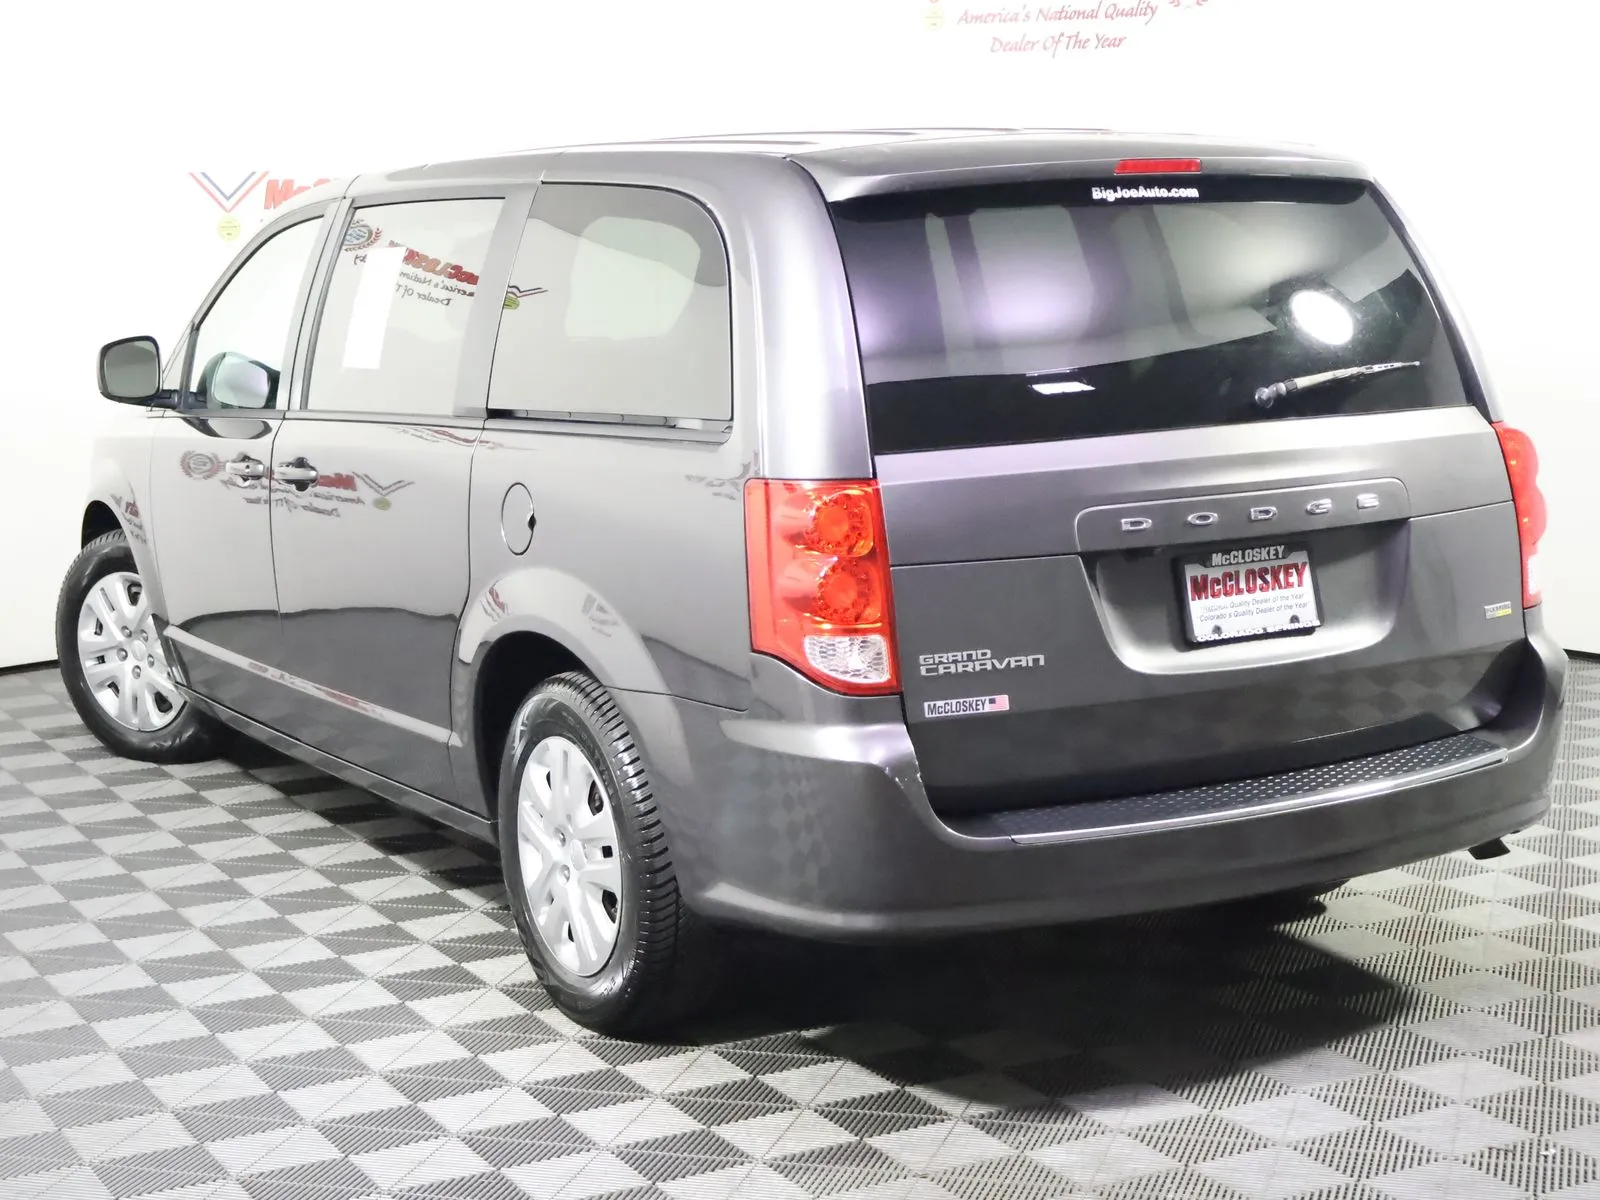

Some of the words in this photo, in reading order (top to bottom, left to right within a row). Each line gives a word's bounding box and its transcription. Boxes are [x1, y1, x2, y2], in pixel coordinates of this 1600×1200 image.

[957, 3, 1031, 25] America's
[1036, 0, 1100, 22] National
[1104, 0, 1158, 26] Quality
[990, 34, 1039, 53] Dealer
[1042, 31, 1065, 58] Of
[1065, 31, 1091, 50] The
[1094, 33, 1128, 49] Year
[1091, 186, 1199, 201] BigJoeAuto.com
[1120, 493, 1380, 532] DODGE
[1212, 545, 1285, 566] McCLOSKEY
[1190, 562, 1307, 601] McCLOSKEY
[1252, 597, 1271, 606] Dealer
[1255, 606, 1275, 615] Dealer
[919, 649, 992, 665] GRAND
[919, 654, 1045, 676] CARAVAN
[927, 699, 987, 716] McCLOSKEY
